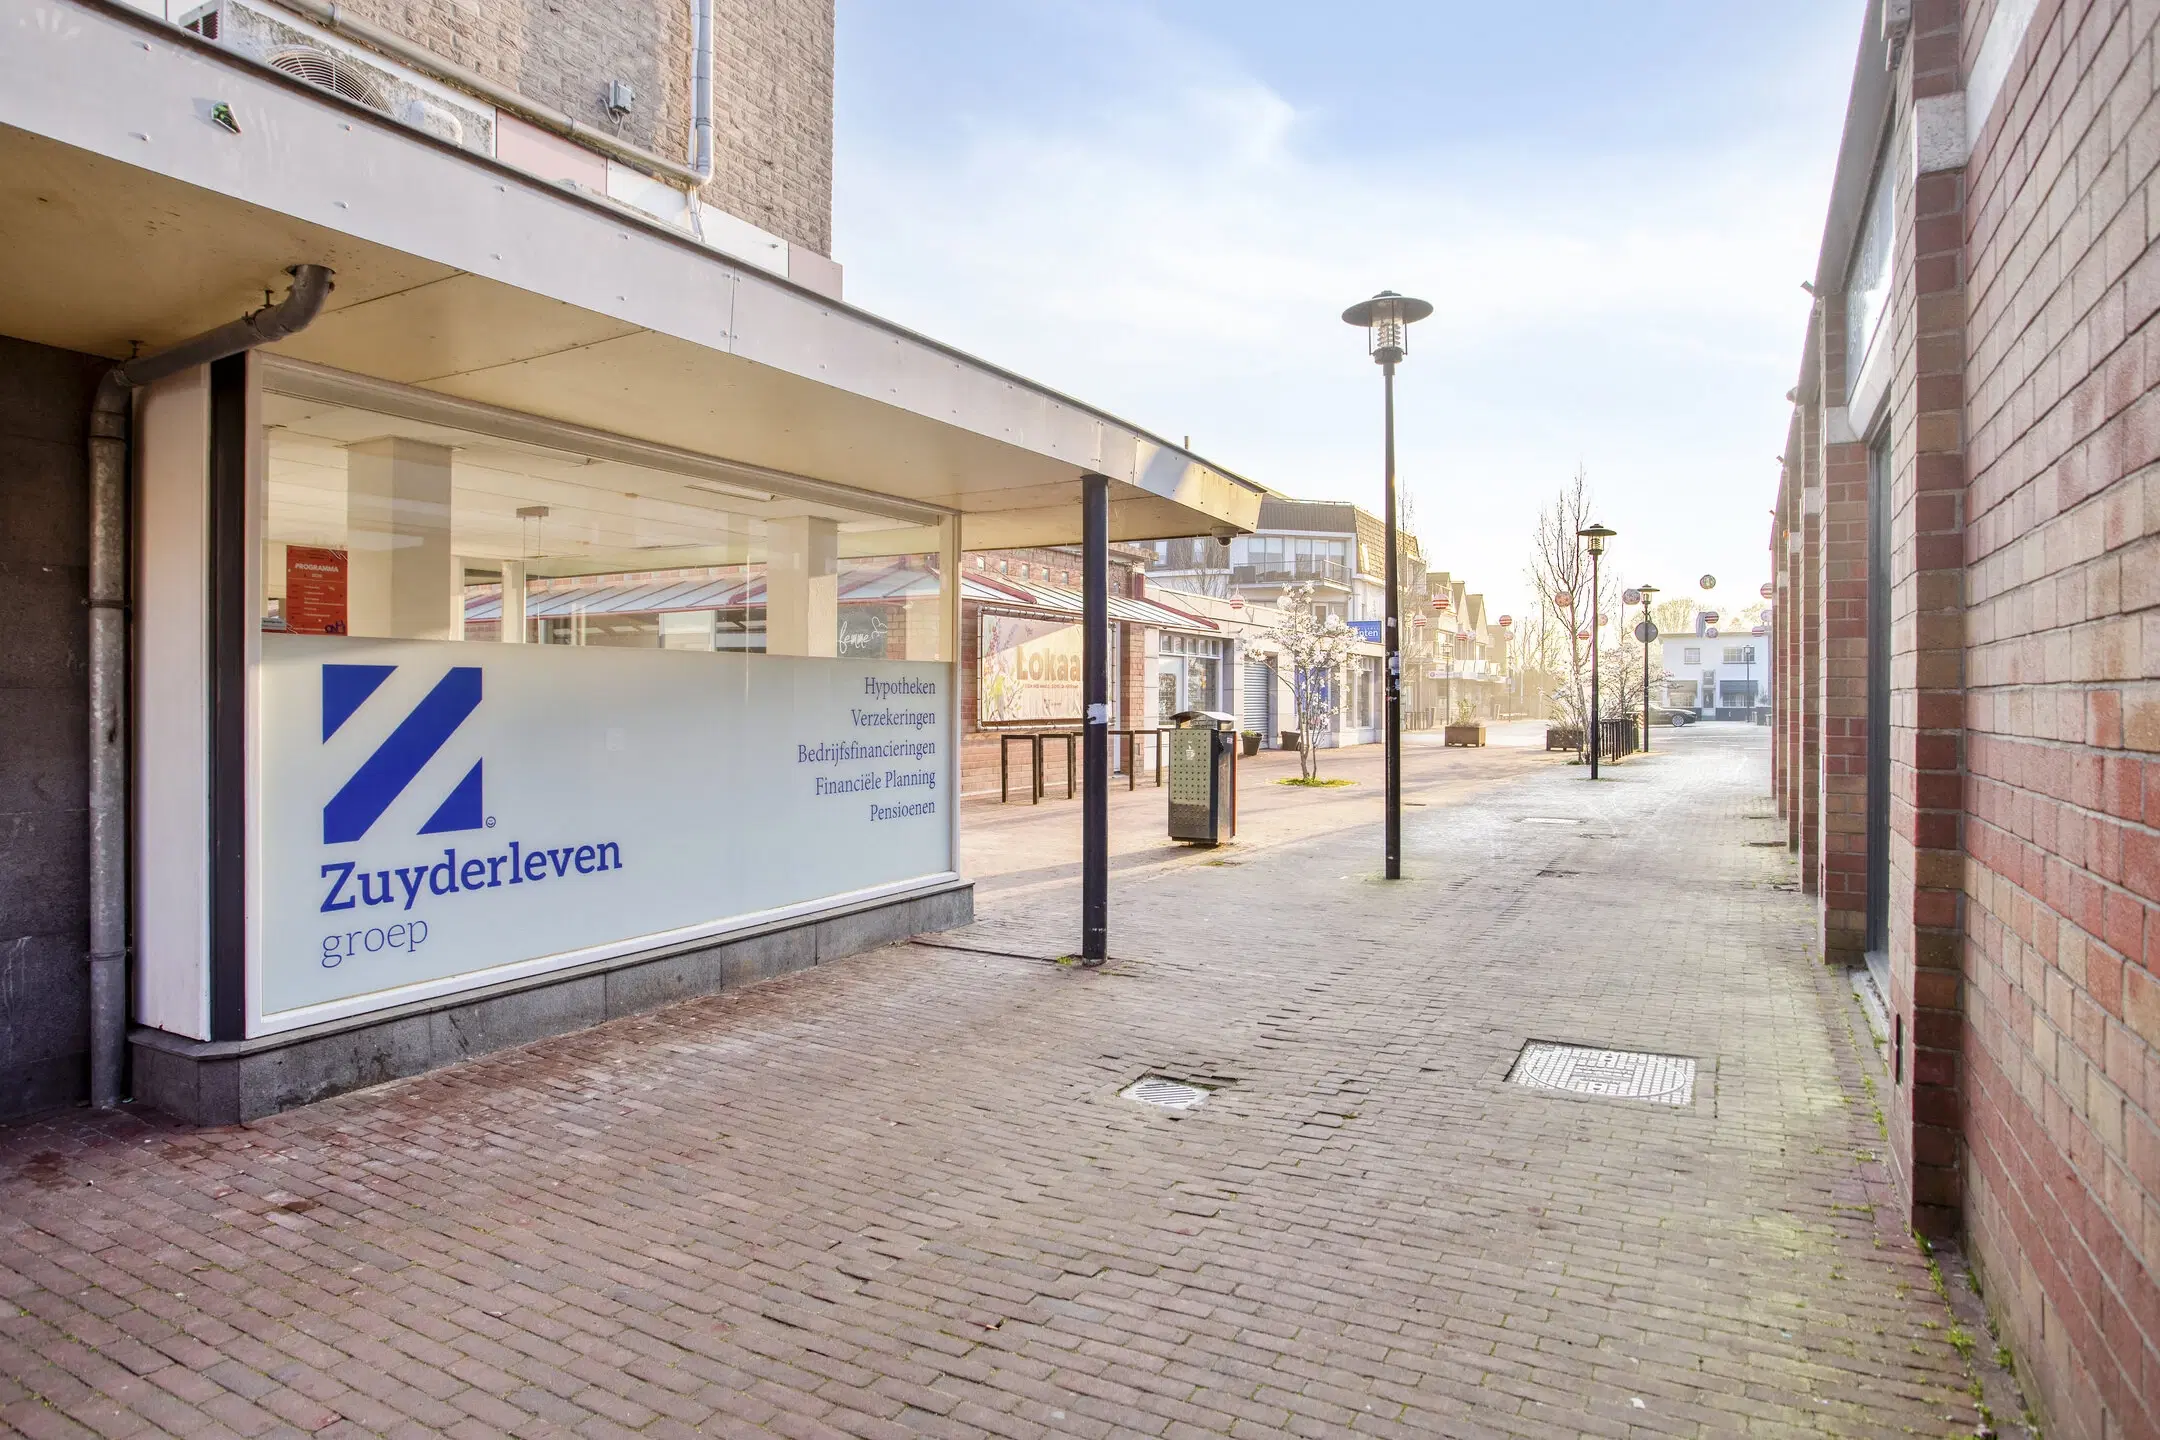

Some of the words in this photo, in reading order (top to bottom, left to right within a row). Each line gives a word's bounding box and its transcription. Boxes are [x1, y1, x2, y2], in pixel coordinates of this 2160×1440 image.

[294, 563, 339, 572] PROGRAMMA
[1016, 645, 1082, 682] Lokaa
[864, 676, 936, 700] Hypotheken
[851, 708, 936, 730] Verzekeringen
[797, 739, 936, 767] Bedrijfsfinancieringen
[815, 772, 882, 795] Financiële
[885, 769, 936, 789] Planning
[870, 801, 935, 821] Pensioenen
[320, 841, 622, 913] Zuyderleven
[321, 920, 428, 968] groep
